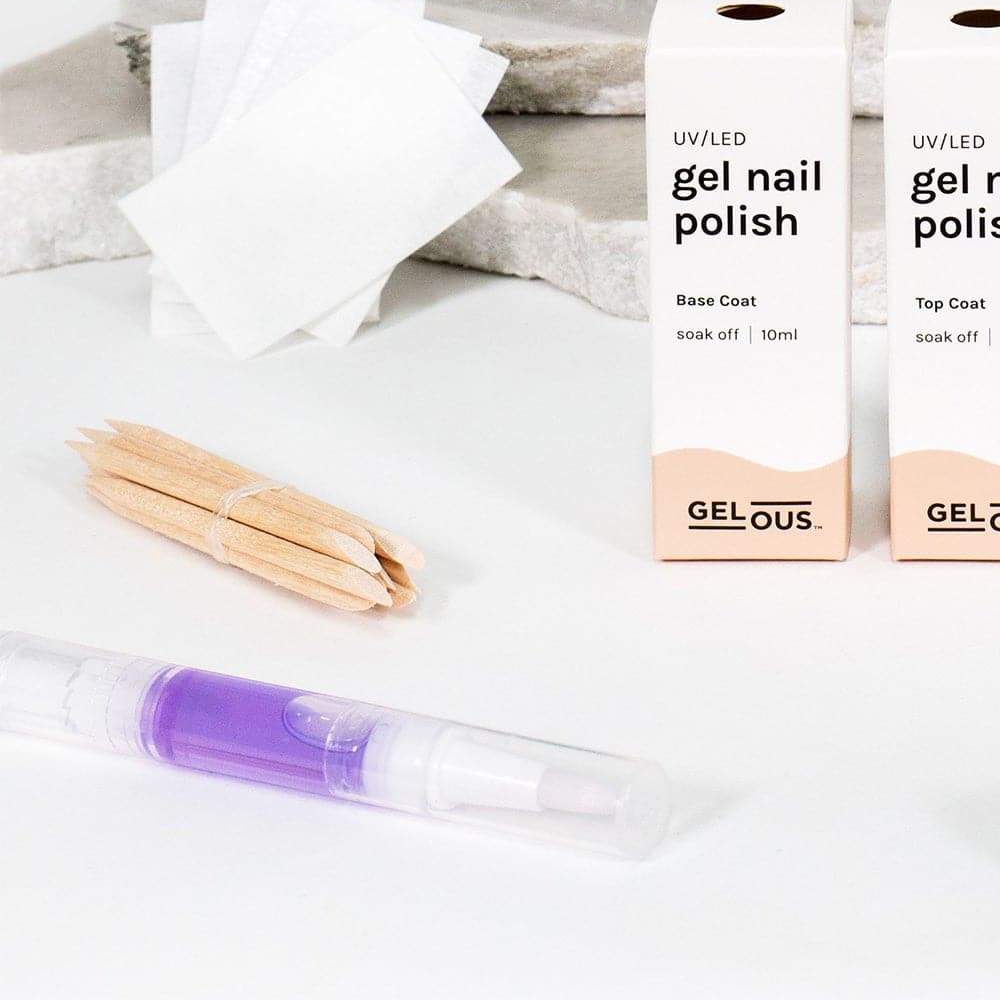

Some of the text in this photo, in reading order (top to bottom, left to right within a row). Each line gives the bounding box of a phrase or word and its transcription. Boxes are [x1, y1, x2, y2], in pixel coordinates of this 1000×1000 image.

[673, 130, 747, 147] UV/LED
[912, 133, 986, 151] UV/LED
[671, 159, 822, 201] gel nail
[910, 163, 969, 205] gel
[674, 204, 799, 245] polish
[676, 294, 758, 308] Base Coat
[915, 296, 987, 313] Top Coat
[676, 327, 799, 342] soak off 10ml
[915, 330, 953, 345] soak
[956, 330, 980, 345] off
